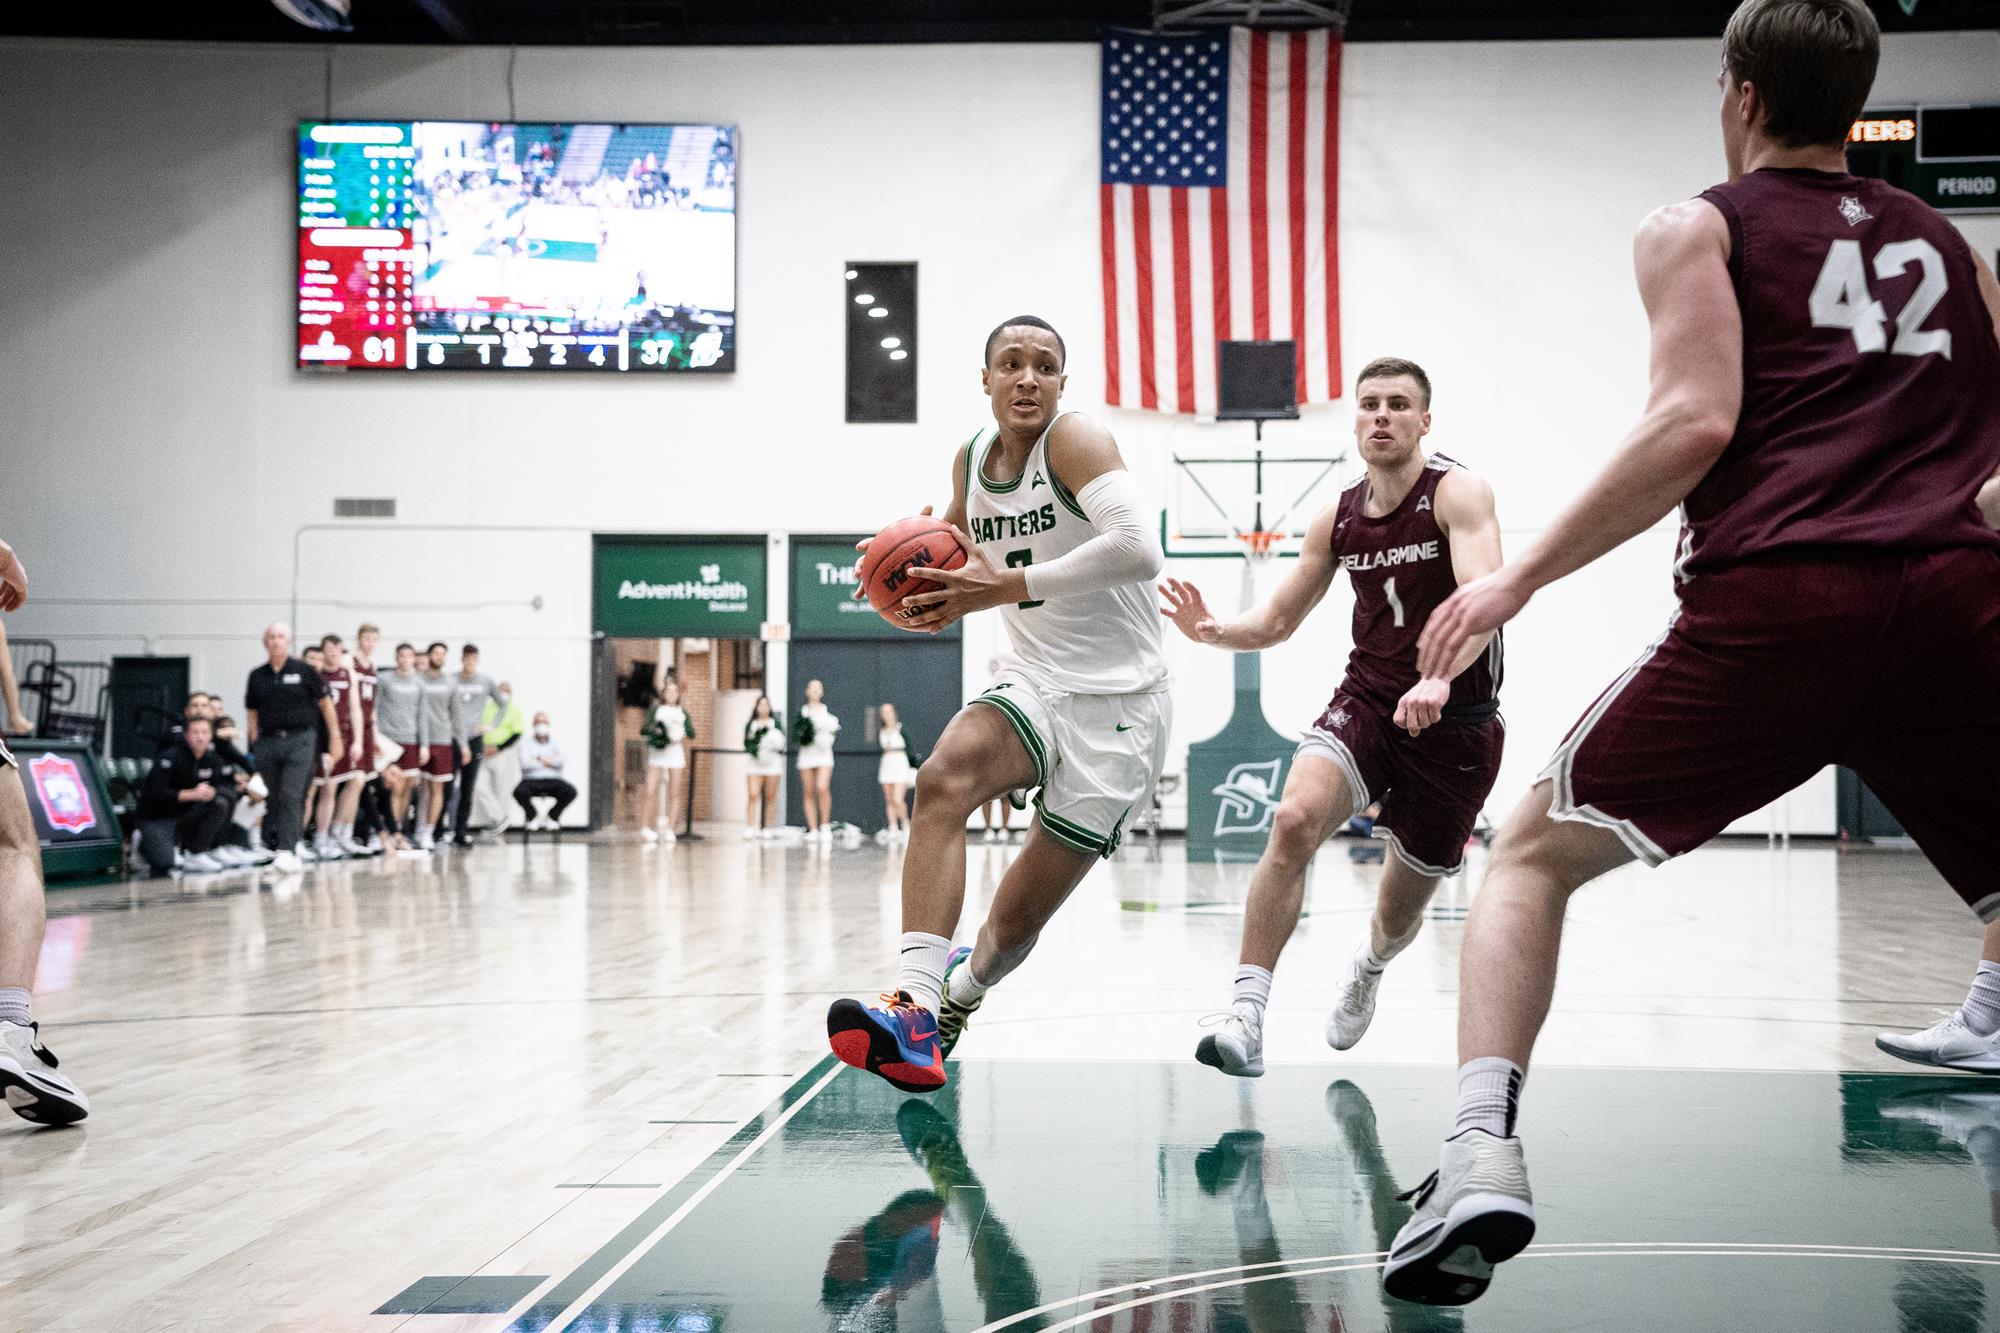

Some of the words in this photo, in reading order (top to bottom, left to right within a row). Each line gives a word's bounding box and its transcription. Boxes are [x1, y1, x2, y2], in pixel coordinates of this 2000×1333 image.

[1937, 177, 1997, 195] PERIOD
[1808, 238, 1952, 361] 42
[641, 339, 674, 364] 37
[971, 502, 1056, 544] HATTERS
[618, 579, 748, 600] AdventHealth
[1383, 576, 1405, 627] 1
